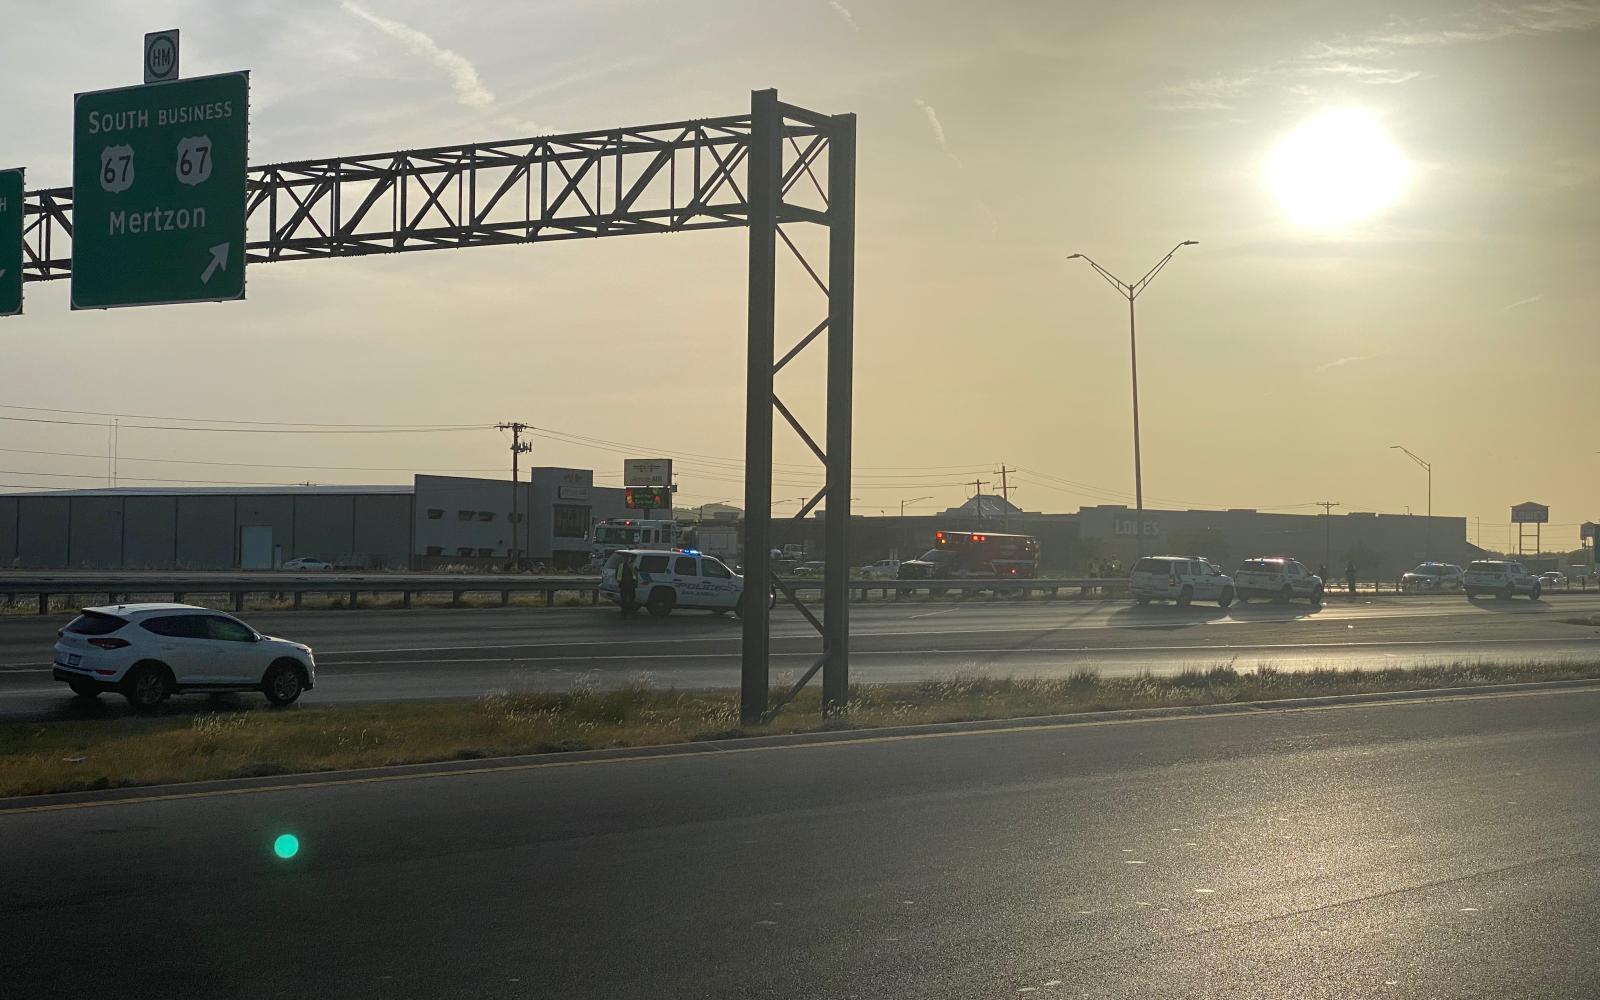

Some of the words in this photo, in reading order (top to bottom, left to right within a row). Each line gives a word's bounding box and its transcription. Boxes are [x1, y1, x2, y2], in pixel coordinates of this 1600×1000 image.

[153, 48, 170, 68] HM
[88, 109, 149, 134] SOUTH
[158, 101, 233, 126] BUSINESS
[103, 155, 131, 184] 67
[180, 146, 209, 176] 67
[109, 206, 206, 236] Mertzon
